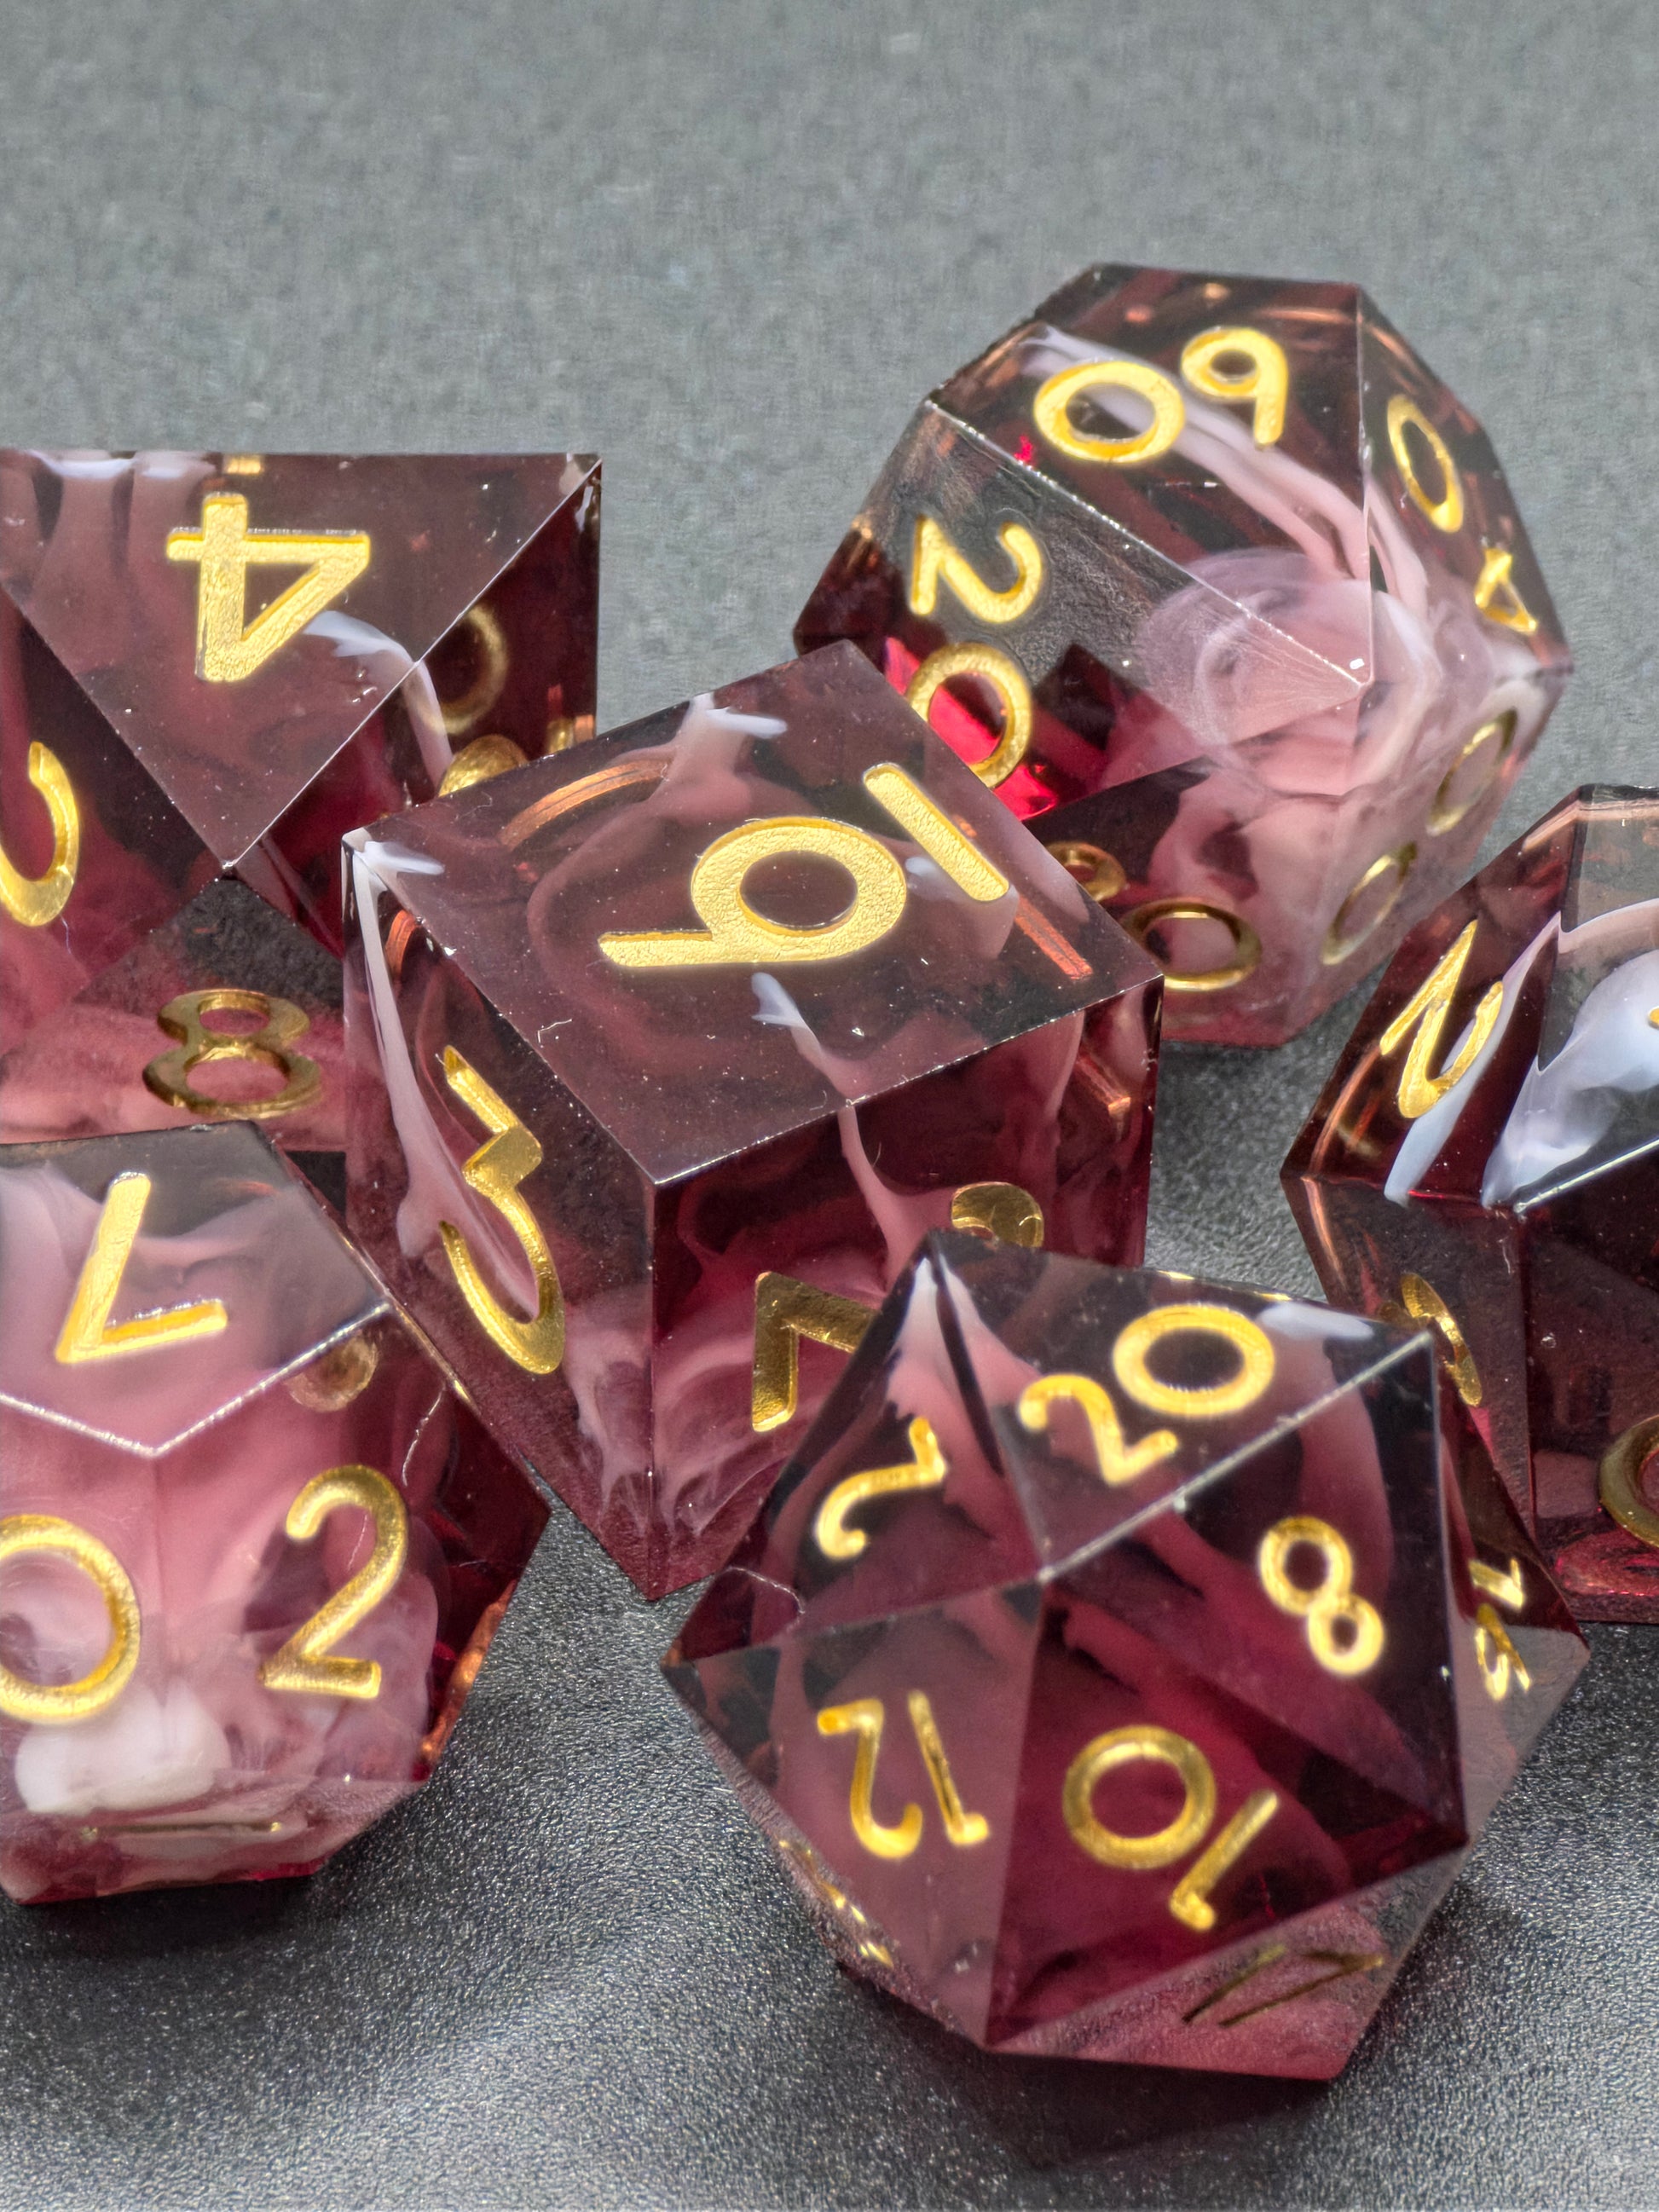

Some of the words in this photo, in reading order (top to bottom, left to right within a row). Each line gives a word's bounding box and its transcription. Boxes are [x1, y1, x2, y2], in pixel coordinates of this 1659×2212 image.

[165, 492, 375, 684] 4
[908, 515, 1046, 791] 20
[142, 989, 323, 1119] 8
[54, 1170, 228, 1366] 7
[816, 1416, 948, 1559] 2
[1020, 1304, 1277, 1487] 20
[262, 1464, 408, 1700] 2
[1258, 1516, 1384, 1677] 8
[816, 1691, 991, 1859] 12
[1062, 1724, 1280, 1931] 10
